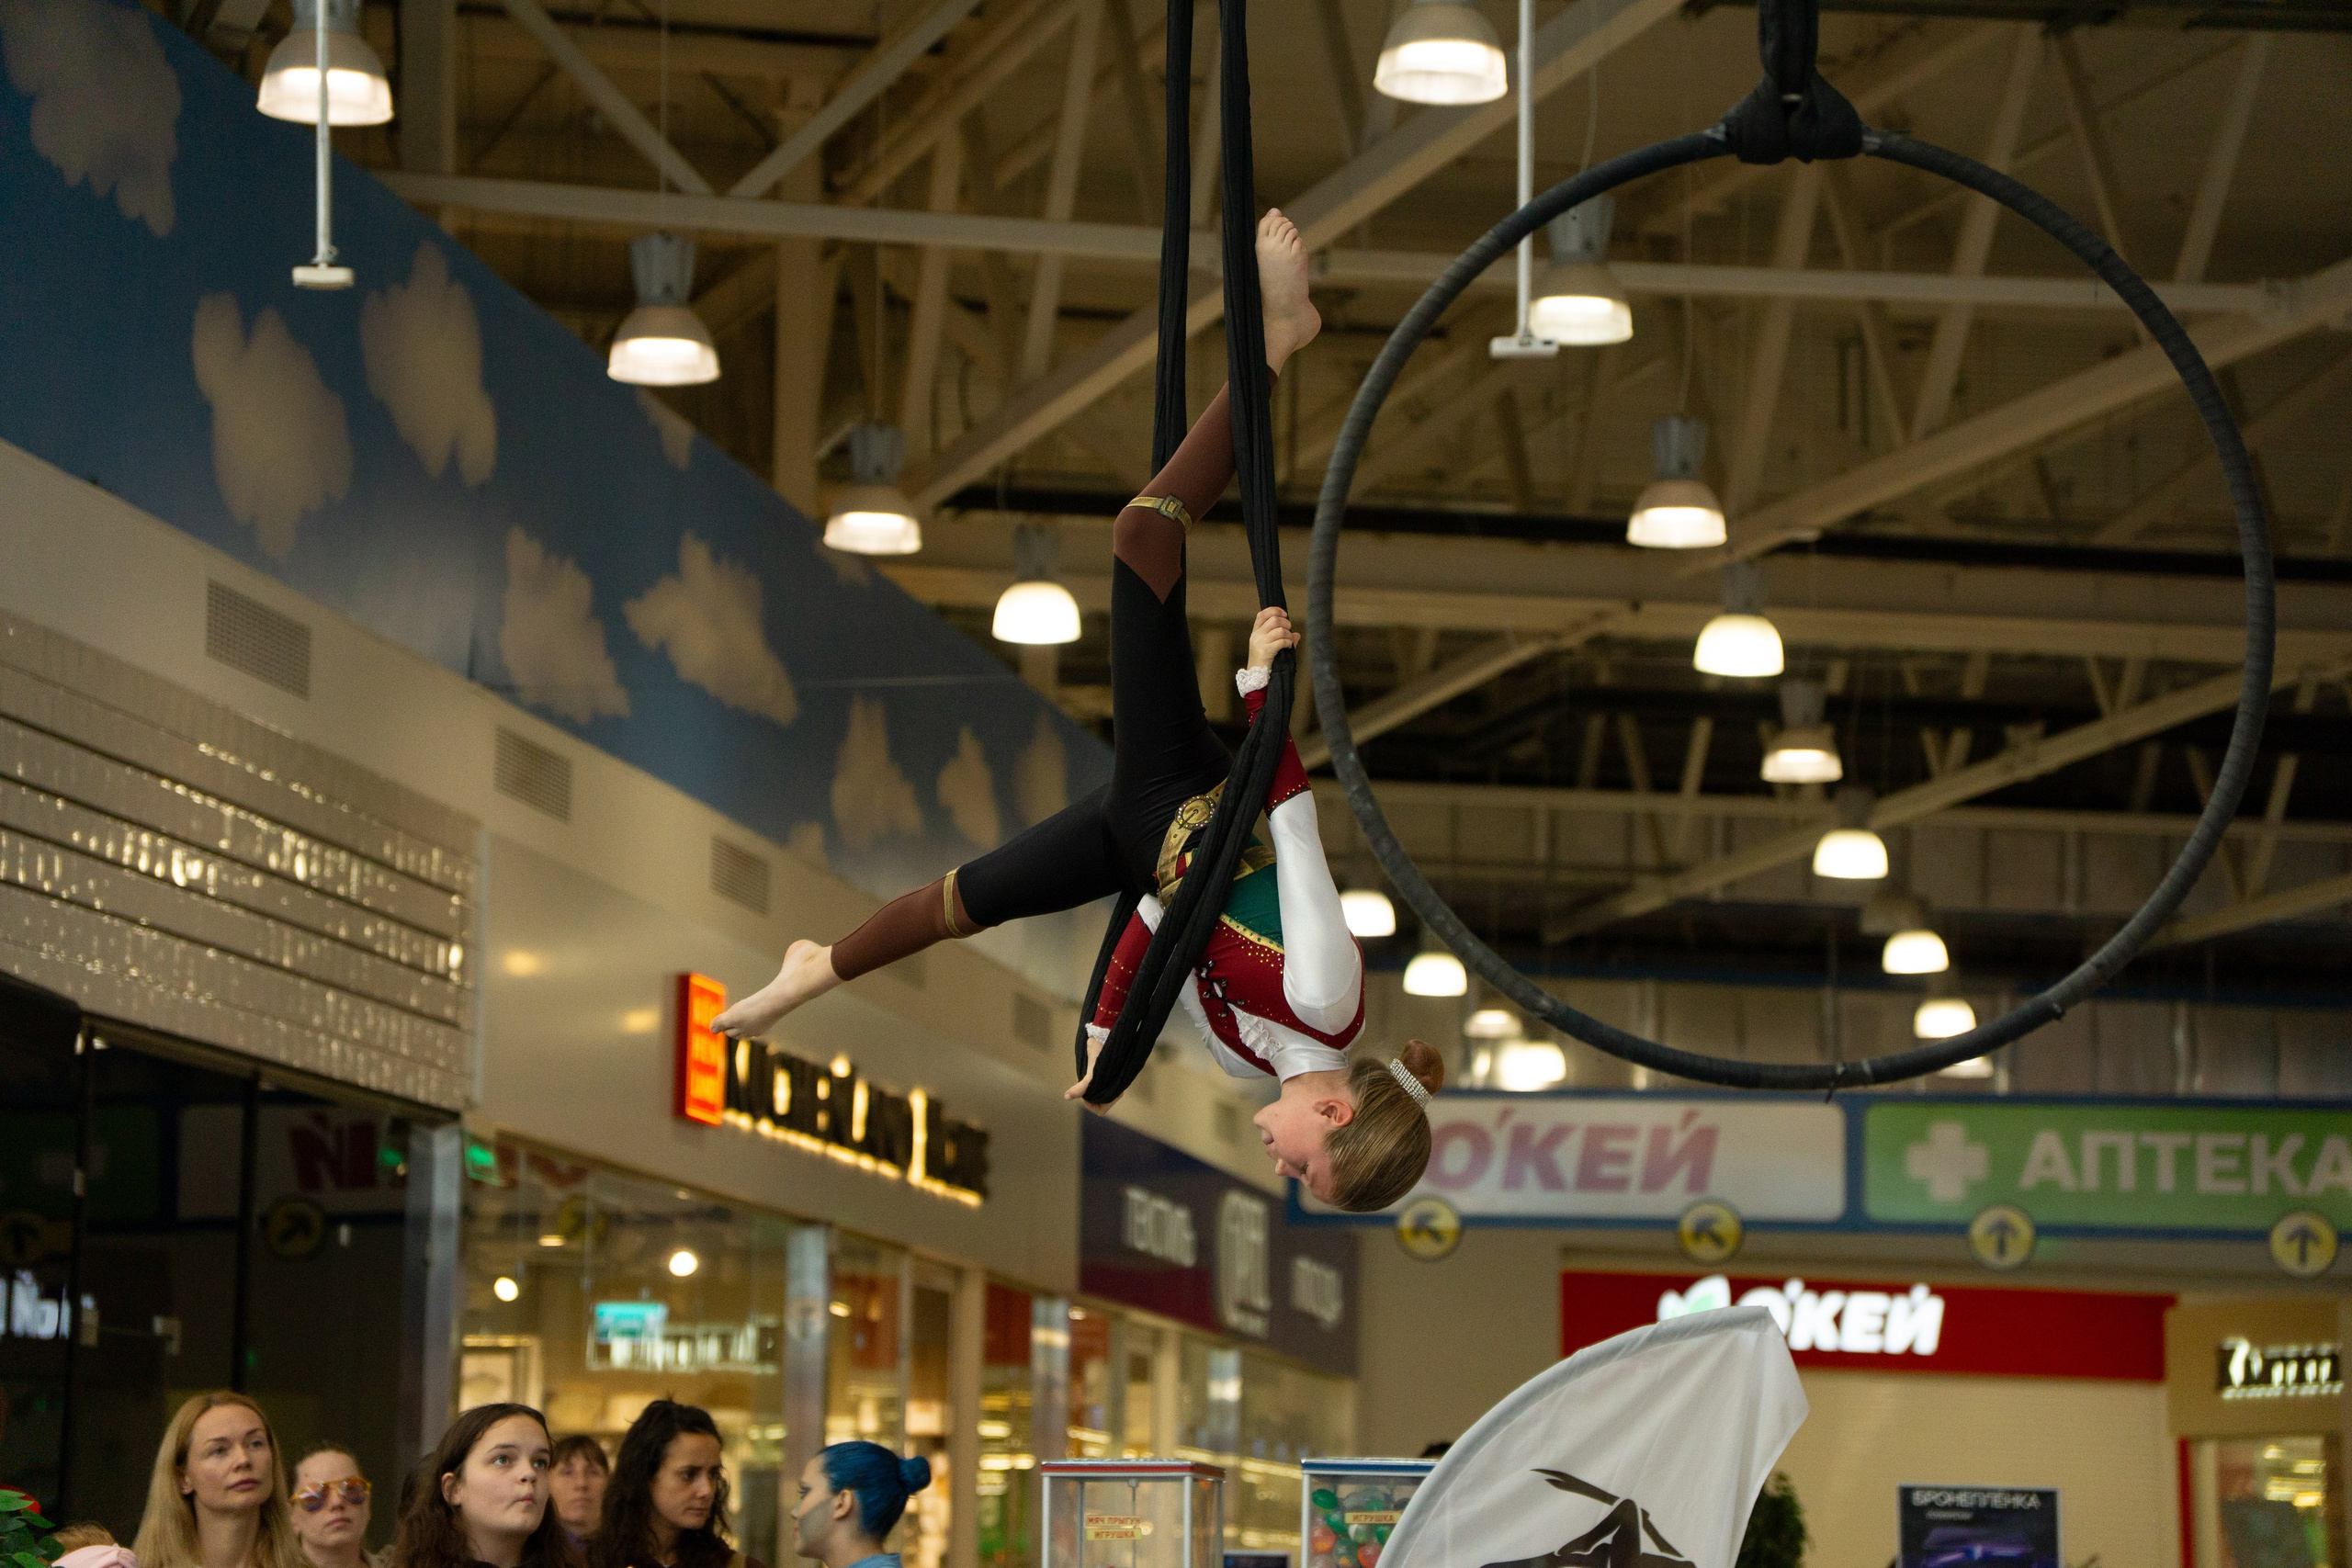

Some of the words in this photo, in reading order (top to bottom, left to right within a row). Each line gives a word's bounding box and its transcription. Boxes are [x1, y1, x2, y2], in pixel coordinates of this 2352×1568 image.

[2019, 1130, 2352, 1194] АПТЕКА
[1352, 1514, 1395, 1522] ИГРУШКА
[1094, 1530, 1136, 1540] ИГРУШКА
